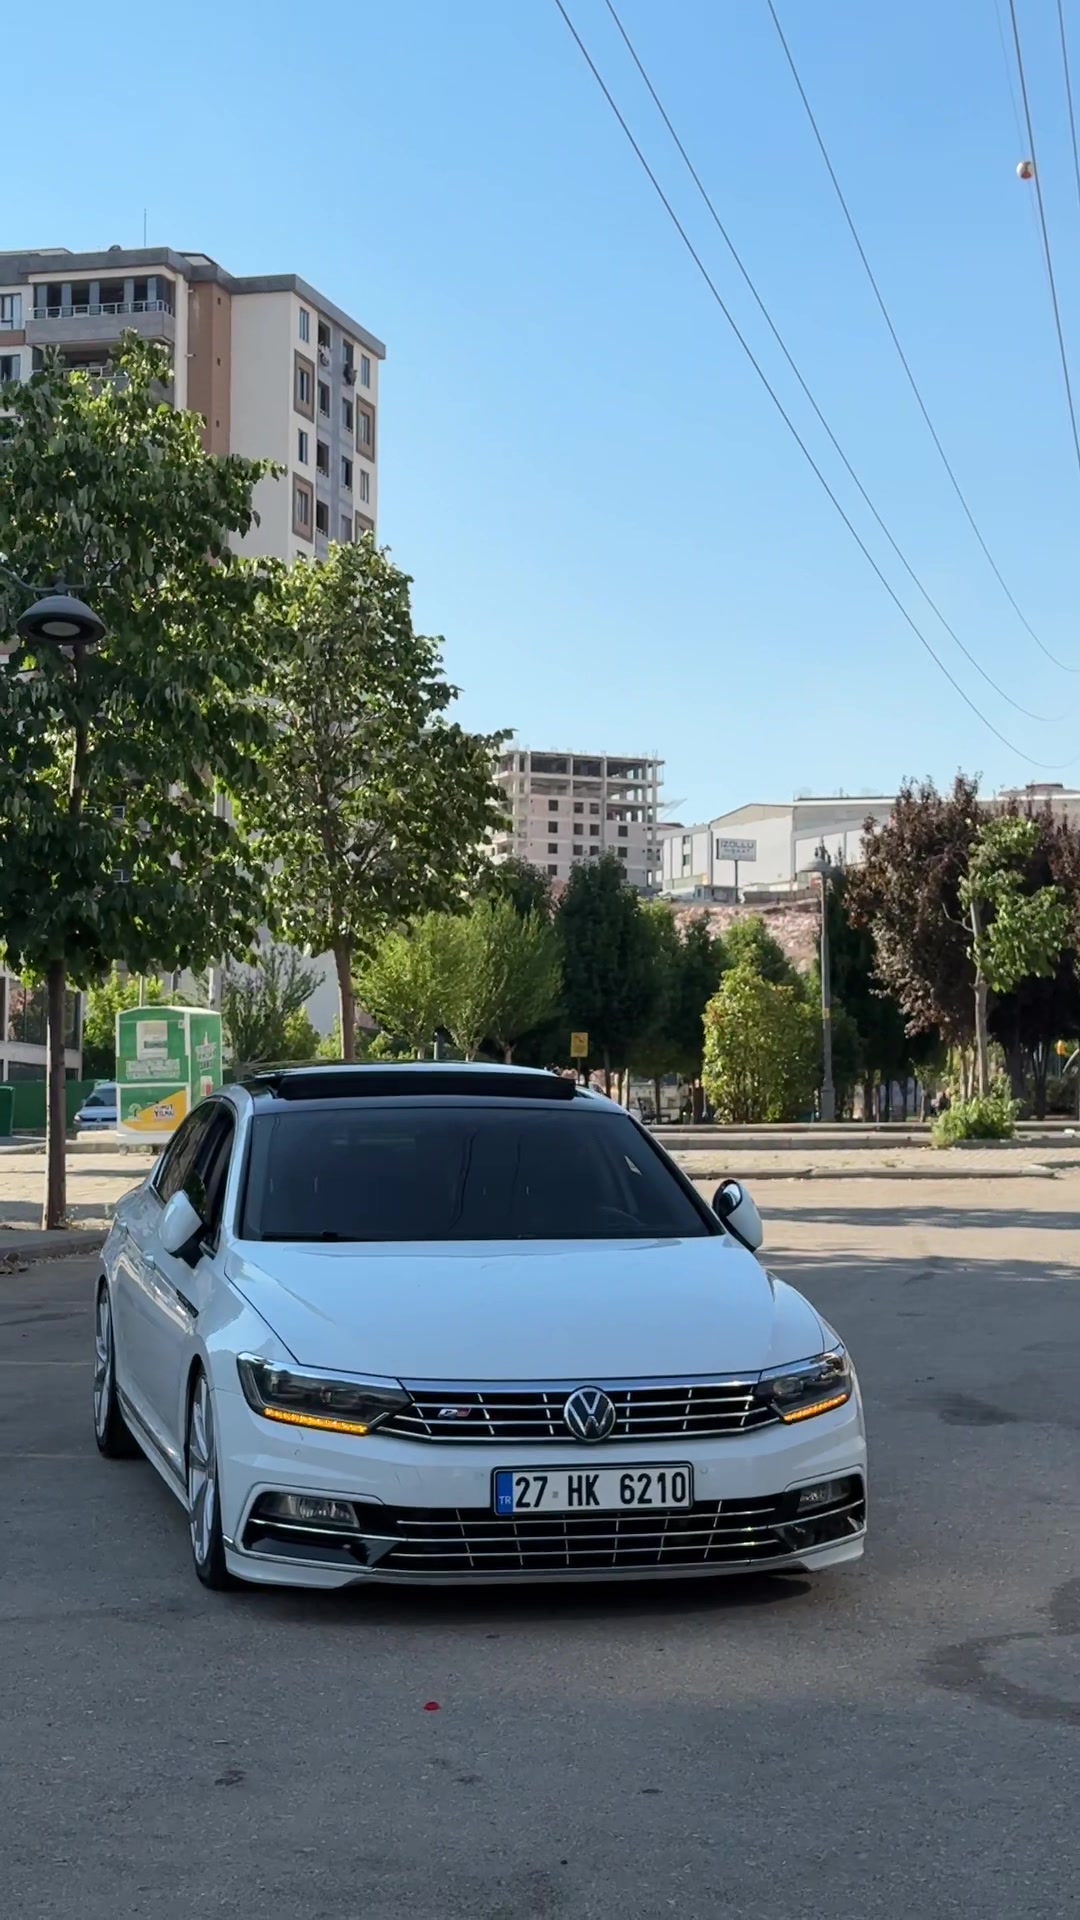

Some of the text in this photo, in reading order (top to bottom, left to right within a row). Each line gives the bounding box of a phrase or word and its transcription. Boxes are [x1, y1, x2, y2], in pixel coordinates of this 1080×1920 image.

[498, 1471, 686, 1508] TR 27 HK 6210
